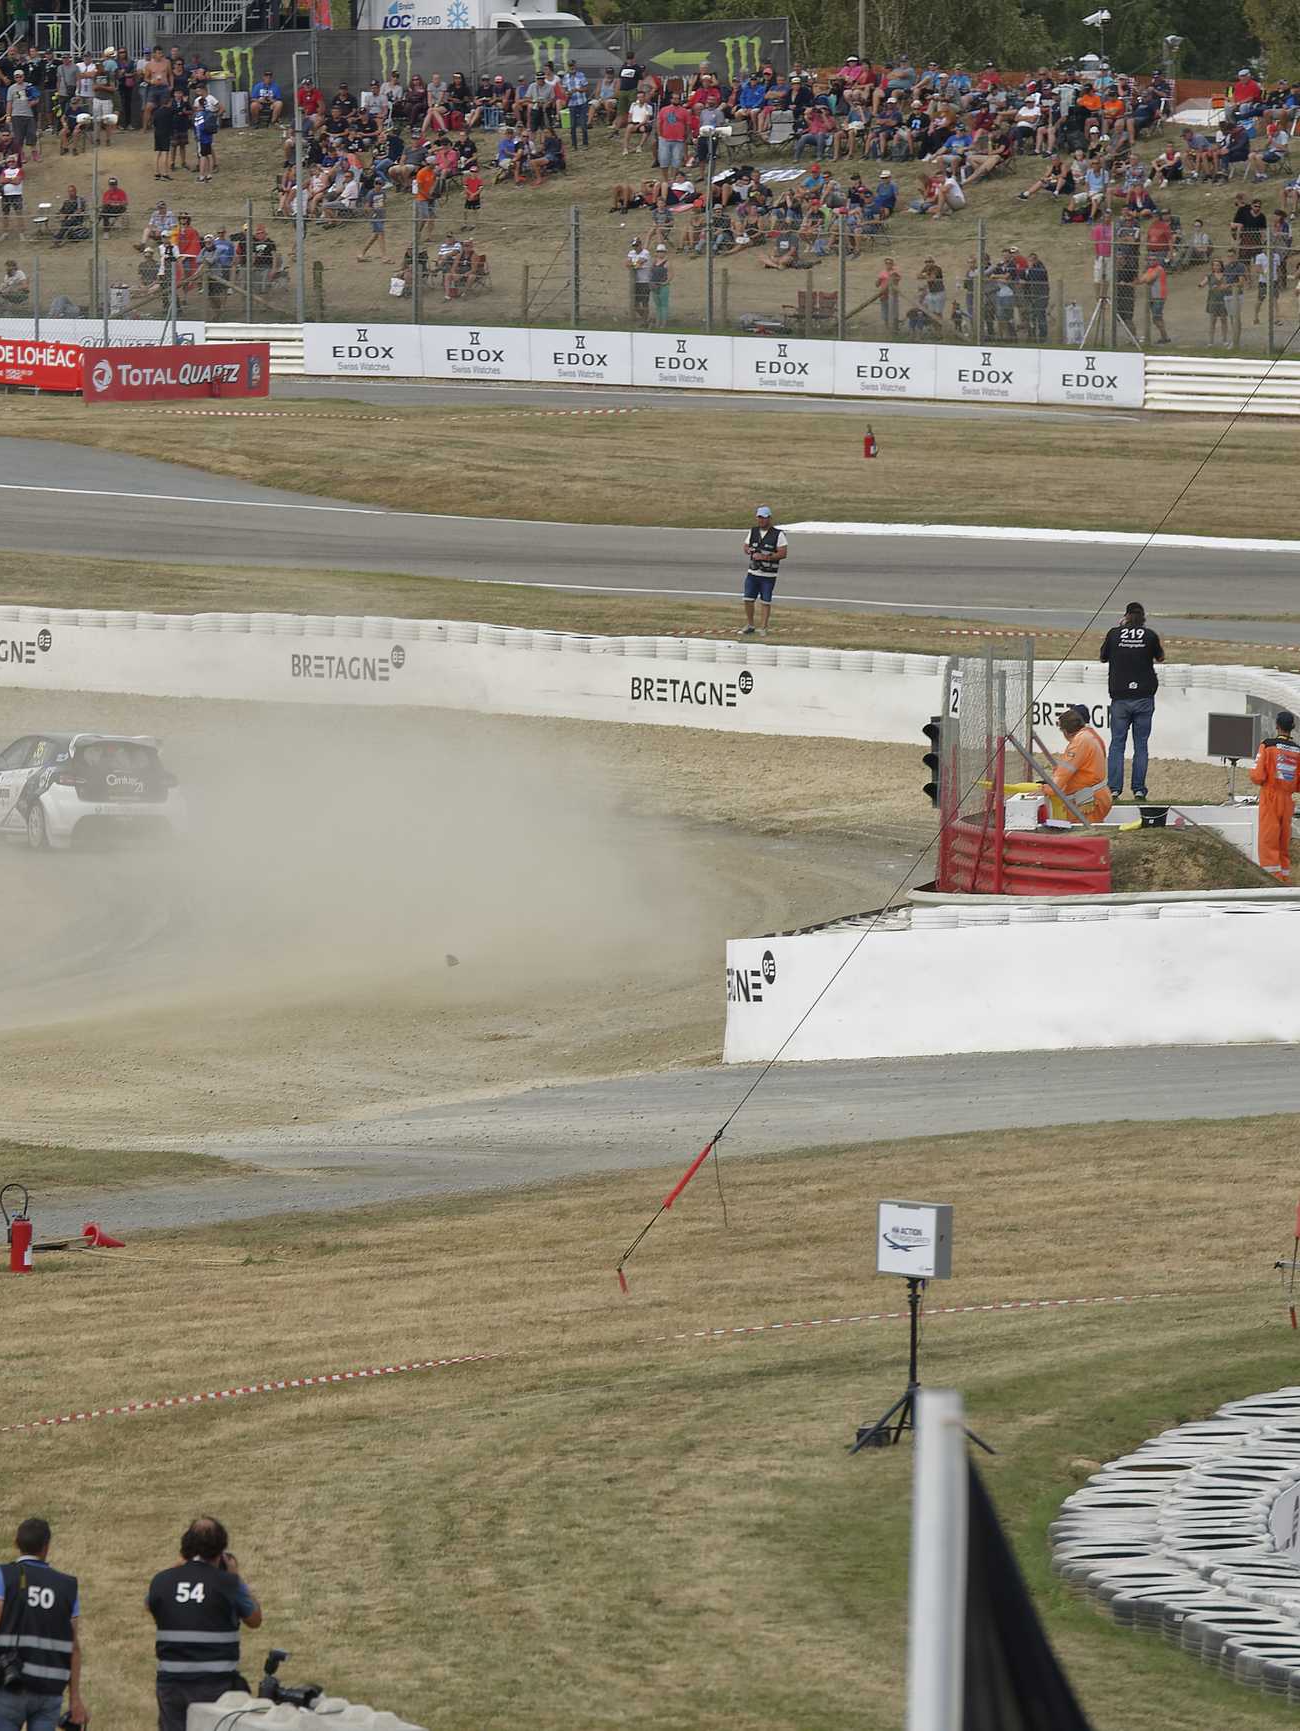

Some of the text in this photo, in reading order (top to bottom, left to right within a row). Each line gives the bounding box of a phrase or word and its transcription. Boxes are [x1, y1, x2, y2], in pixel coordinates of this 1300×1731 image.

[417, 16, 441, 26] FROID
[17, 345, 76, 368] LOHÉAC
[332, 346, 394, 359] EDOX
[446, 349, 504, 362] EDOX
[553, 352, 607, 367] EDOX
[655, 357, 708, 371] EDOX
[755, 361, 809, 375] EDOX
[117, 364, 177, 386] TOTAL
[857, 366, 910, 380] EDOX
[958, 370, 1013, 384] EDOX
[1062, 374, 1118, 388] EDOX
[1120, 628, 1145, 639] 219
[291, 654, 390, 682] BRETAGNE
[631, 677, 737, 707] BRETAGNE
[951, 688, 959, 712] 2
[27, 1586, 55, 1609] 50
[175, 1582, 205, 1603] 54
